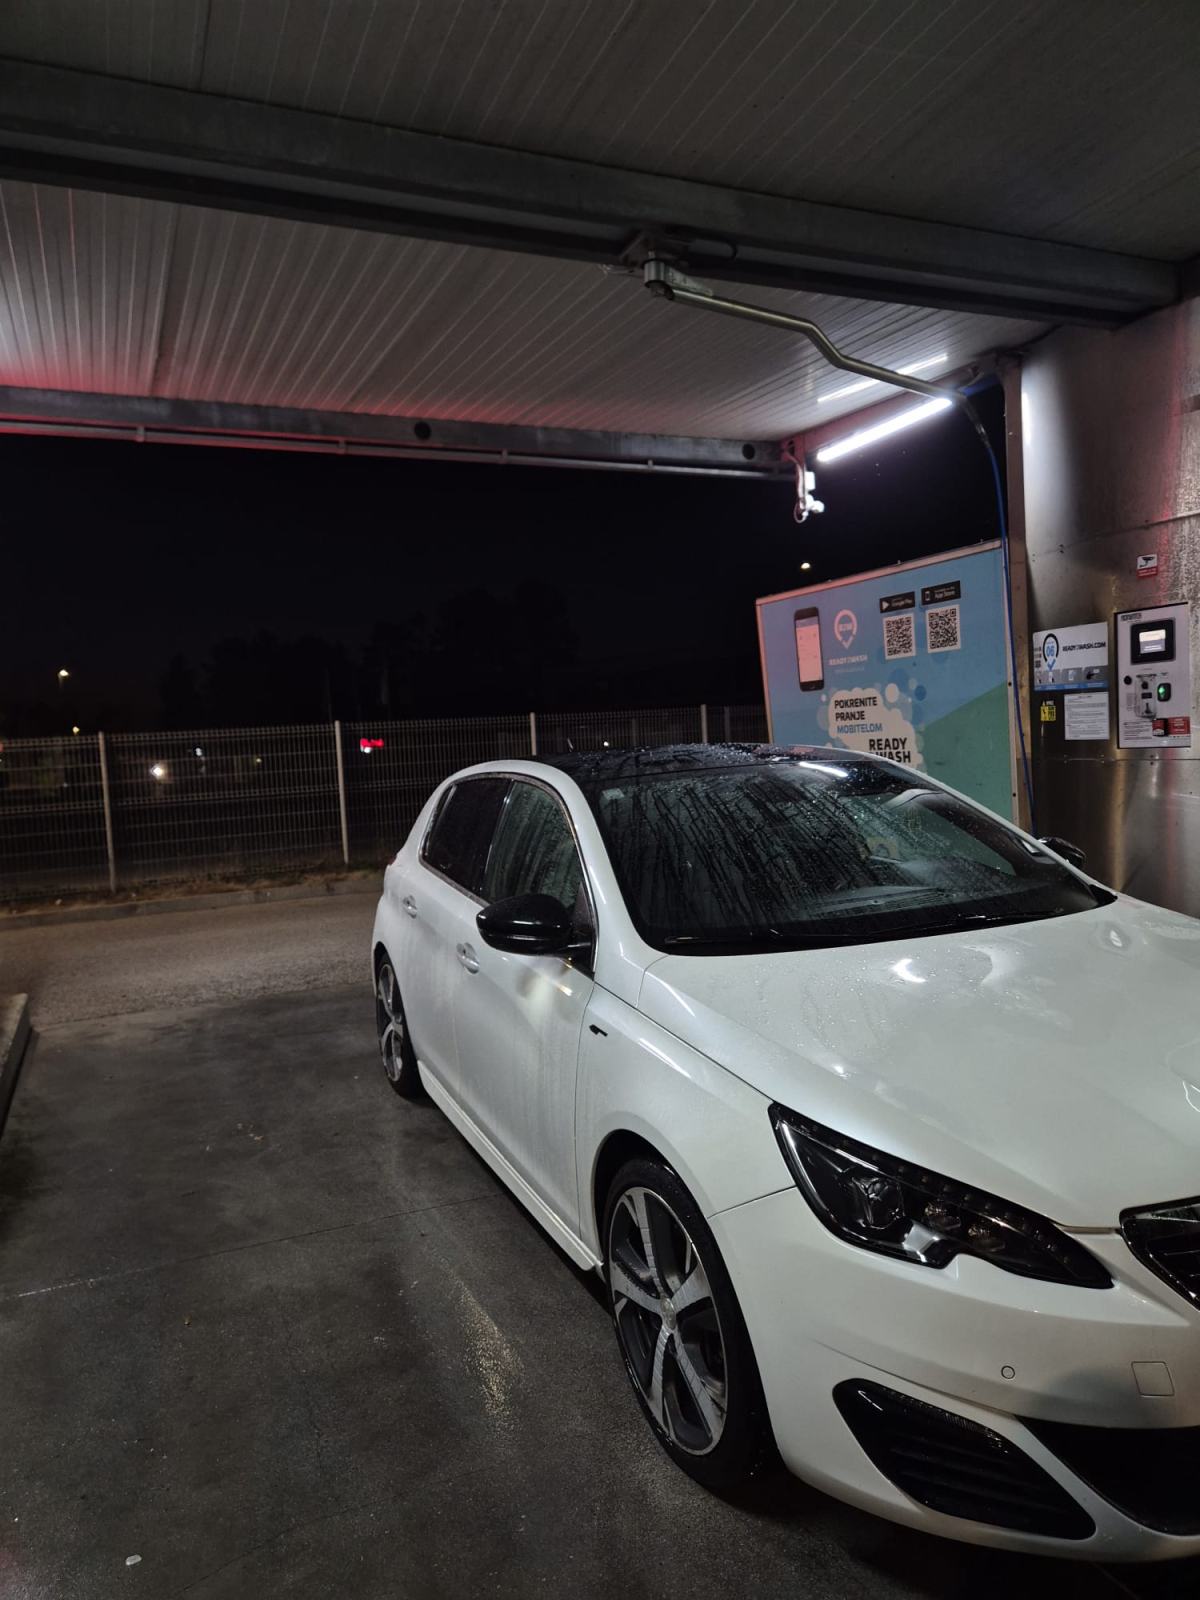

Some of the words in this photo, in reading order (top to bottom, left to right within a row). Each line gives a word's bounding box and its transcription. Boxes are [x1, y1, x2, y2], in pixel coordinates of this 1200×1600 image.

[834, 696, 878, 709] POKRENITE
[835, 710, 865, 721] PRANJE
[837, 723, 883, 734] MOBITELOM
[869, 737, 907, 751] READY
